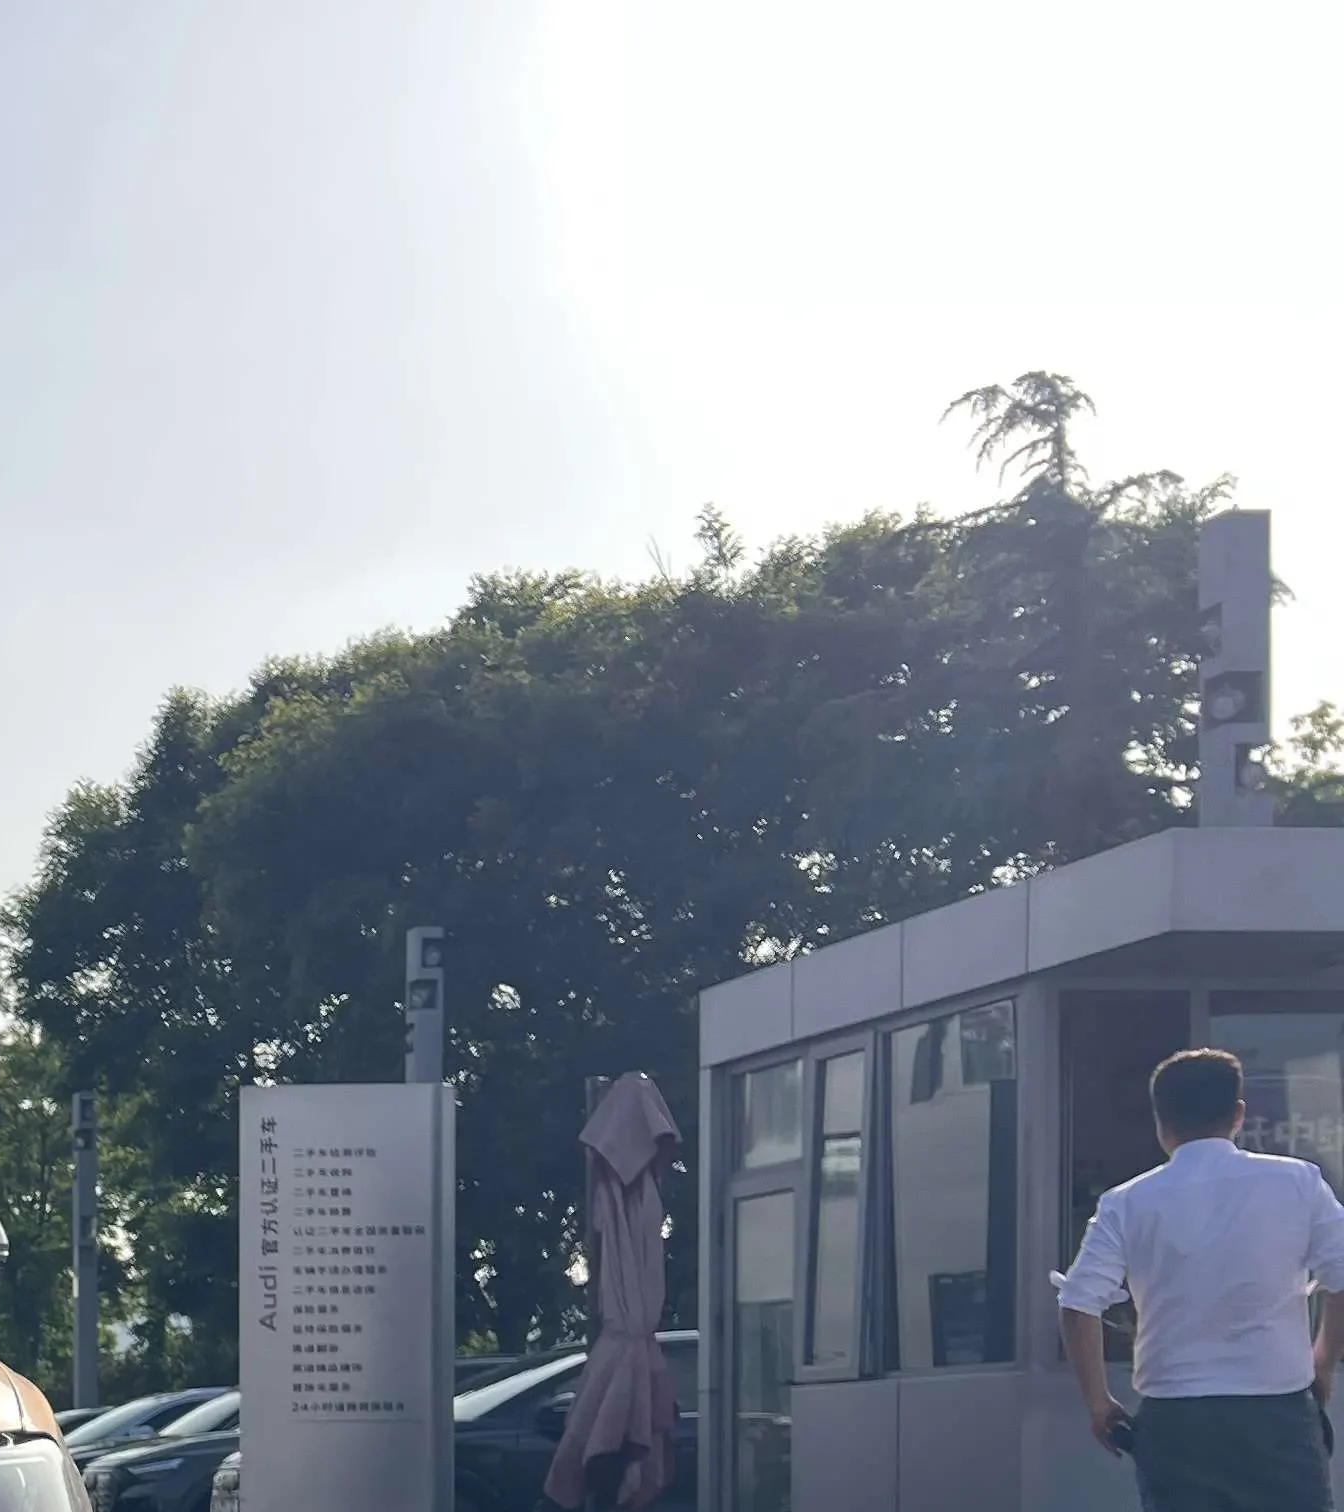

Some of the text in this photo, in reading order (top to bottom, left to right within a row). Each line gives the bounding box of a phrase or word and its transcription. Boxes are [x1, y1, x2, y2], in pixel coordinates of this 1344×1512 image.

[259, 1115, 279, 1332] Audi 官方认证二手车
